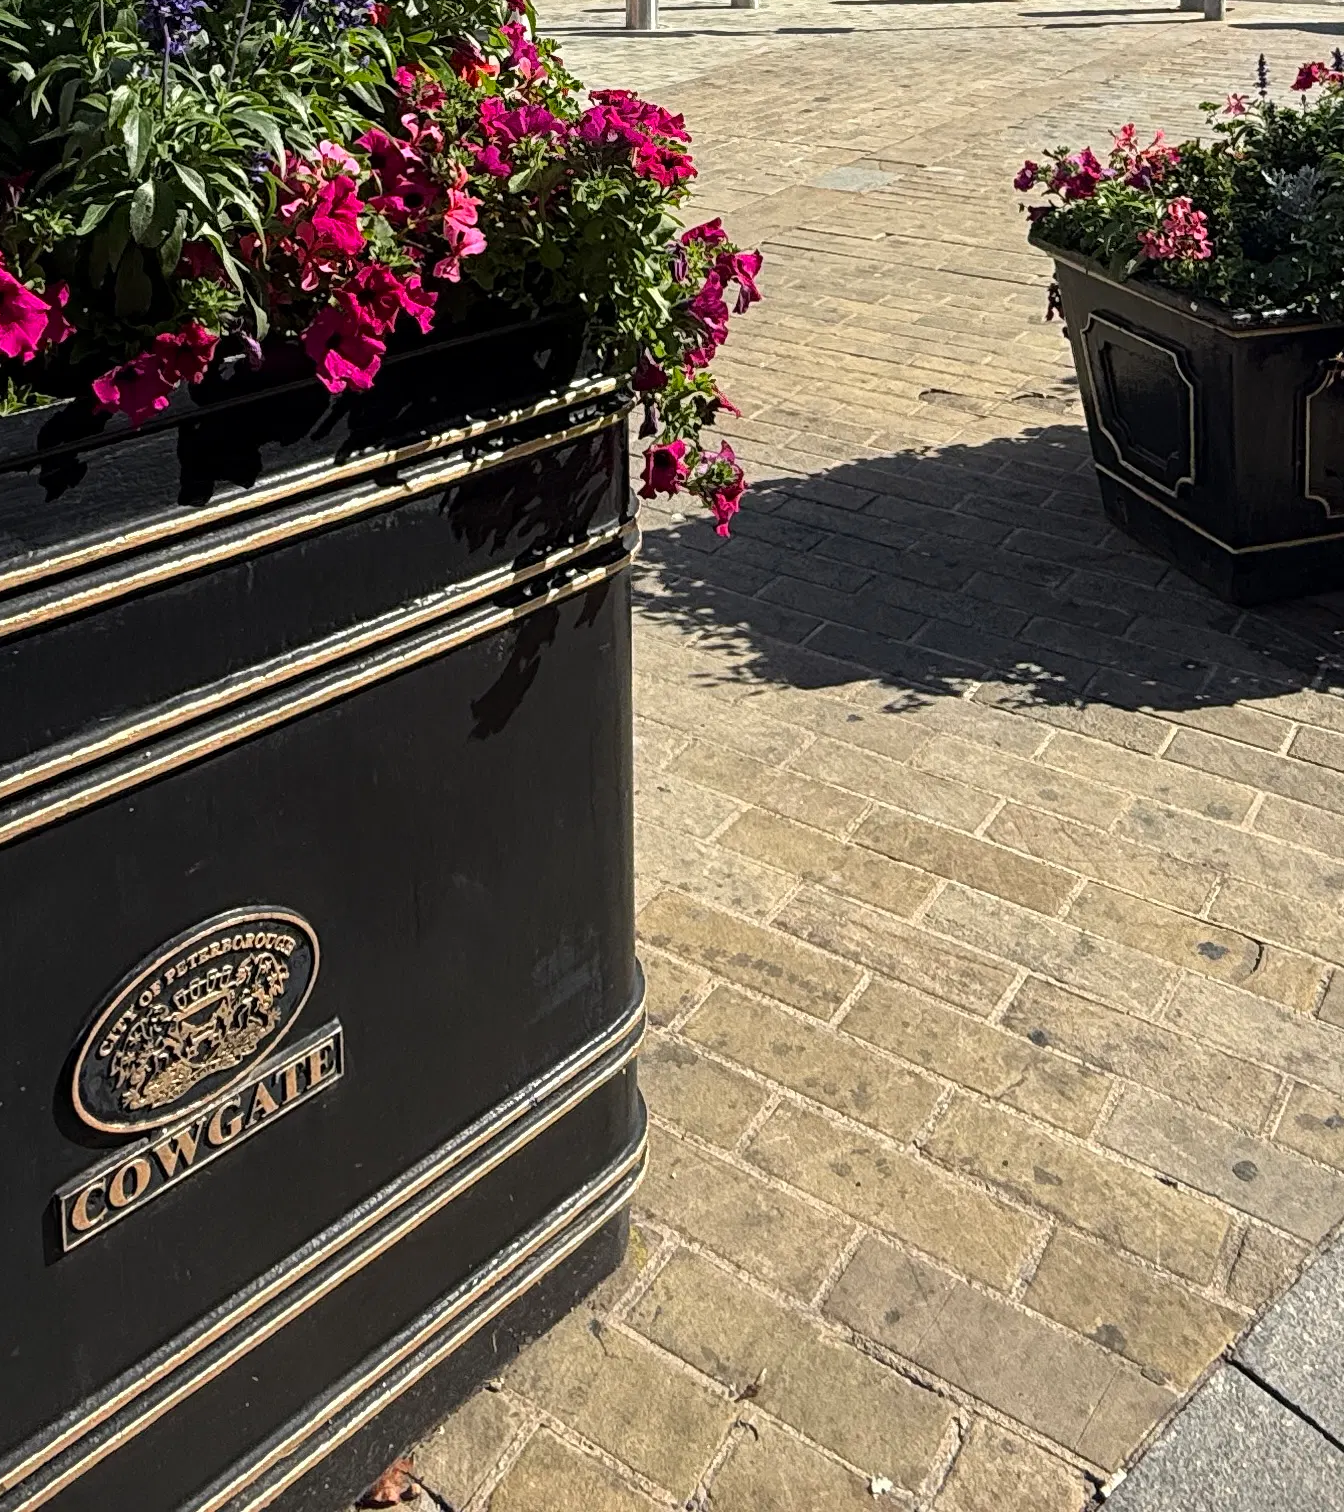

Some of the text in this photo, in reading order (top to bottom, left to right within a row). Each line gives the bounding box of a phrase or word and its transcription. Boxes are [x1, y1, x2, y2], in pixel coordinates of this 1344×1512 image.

[99, 932, 296, 1057] CITY OF PETERBOROUGH
[71, 1038, 337, 1231] COWGATE
